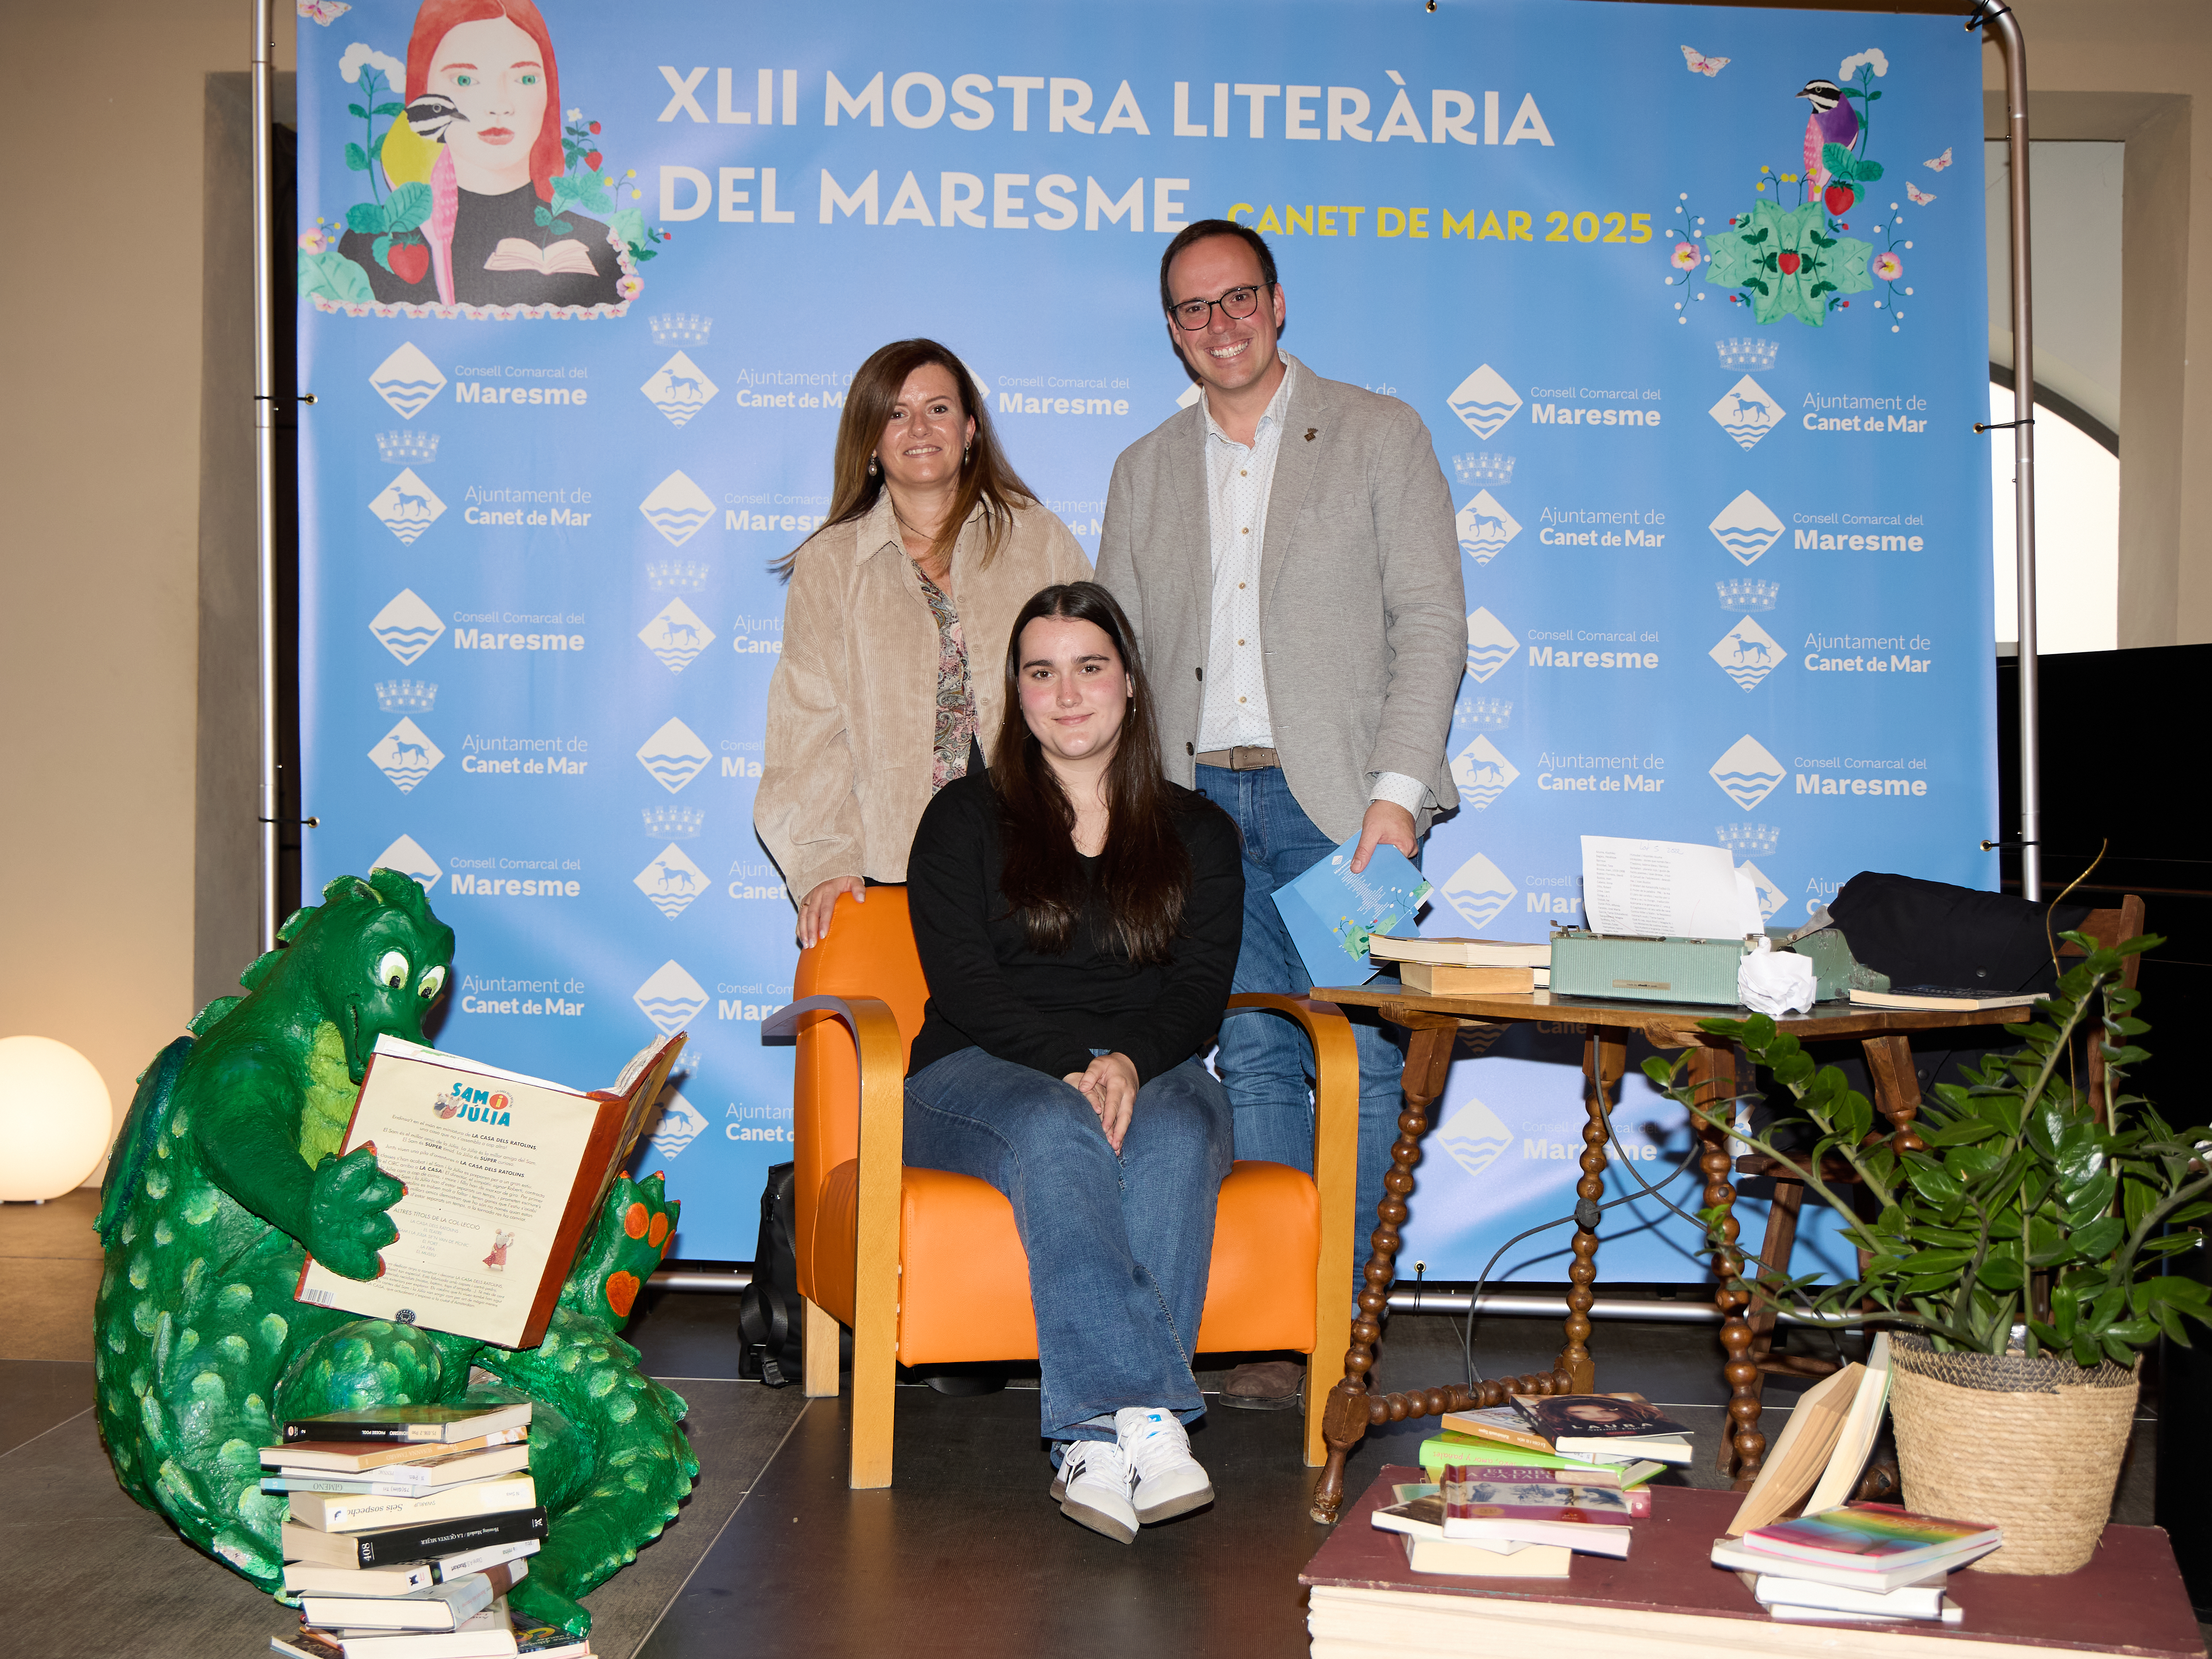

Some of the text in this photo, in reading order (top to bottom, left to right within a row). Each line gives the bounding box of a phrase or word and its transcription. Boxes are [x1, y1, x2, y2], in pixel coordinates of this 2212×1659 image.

[657, 66, 1555, 147] XLII MOSTRA LITERÀRIA
[657, 166, 1189, 235] DEL MARESME
[1227, 202, 1653, 244] CANET DE MAR 2025
[454, 365, 588, 379] Consell Comarcal del
[736, 368, 838, 388] Ajuntament
[998, 375, 1130, 389] Consell Comarcal del
[1376, 382, 1397, 397] de
[456, 382, 587, 405] Maresme
[736, 389, 796, 407] Canet
[798, 392, 819, 408] de
[1530, 386, 1662, 400] Consell Comarcal del
[1802, 392, 1927, 412] Ajuntament de
[999, 392, 1129, 416] Maresme
[1532, 403, 1661, 426] Maresme
[1803, 412, 1928, 433] Canet de Mar
[464, 485, 591, 505] Ajuntament de
[725, 493, 833, 505] Consell Comarca
[464, 506, 591, 526] Canet de Mar
[726, 510, 828, 532] Mares
[1540, 506, 1665, 527] Ajuntament de
[1793, 512, 1924, 526] Consell Comarcal del
[1068, 520, 1087, 536] de
[1539, 527, 1665, 547] Canet de Mar
[1794, 529, 1924, 552] Maresme
[453, 611, 585, 625] Consell Comarcal del
[454, 628, 585, 651] Maresme
[733, 635, 783, 654] Cane
[1528, 629, 1659, 642] Consell Comarcal del
[1804, 633, 1931, 652] Ajuntament de
[1529, 646, 1659, 669] Maresme
[1804, 653, 1931, 673] Canet de Mar
[461, 734, 588, 754] Ajuntament de
[721, 740, 766, 751] Consell
[461, 755, 588, 774] Canet de Mar
[1537, 751, 1664, 772] Ajuntament de
[1794, 757, 1927, 770] Consell Comarcal del
[1537, 772, 1664, 792] Canet de Mar
[1796, 774, 1927, 796] Maresme
[450, 857, 581, 870] Consell Comarcal del
[451, 873, 580, 897] Maresme
[728, 881, 787, 900] Canet
[1526, 875, 1572, 887] Consell
[461, 974, 585, 995] Ajuntament de
[717, 982, 763, 995] Consell
[461, 995, 585, 1016] Canet de Mar
[450, 1082, 490, 1105] SAM
[456, 1104, 511, 1127] JÚLIA
[726, 1123, 784, 1142] Canet
[1522, 1121, 1569, 1133] Consell
[393, 1207, 413, 1218] ALTRES
[413, 1210, 431, 1220] TÍTOLS
[386, 1450, 409, 1460] TAMARO
[409, 1447, 433, 1457] SUSANNA
[1433, 1451, 1463, 1460] pañales
[313, 1483, 343, 1491] GIMENO
[347, 1504, 403, 1517] Seis sospecho
[438, 1533, 456, 1543] QUINTA
[361, 1543, 372, 1561] 408
[451, 1562, 467, 1571] Stuckart
